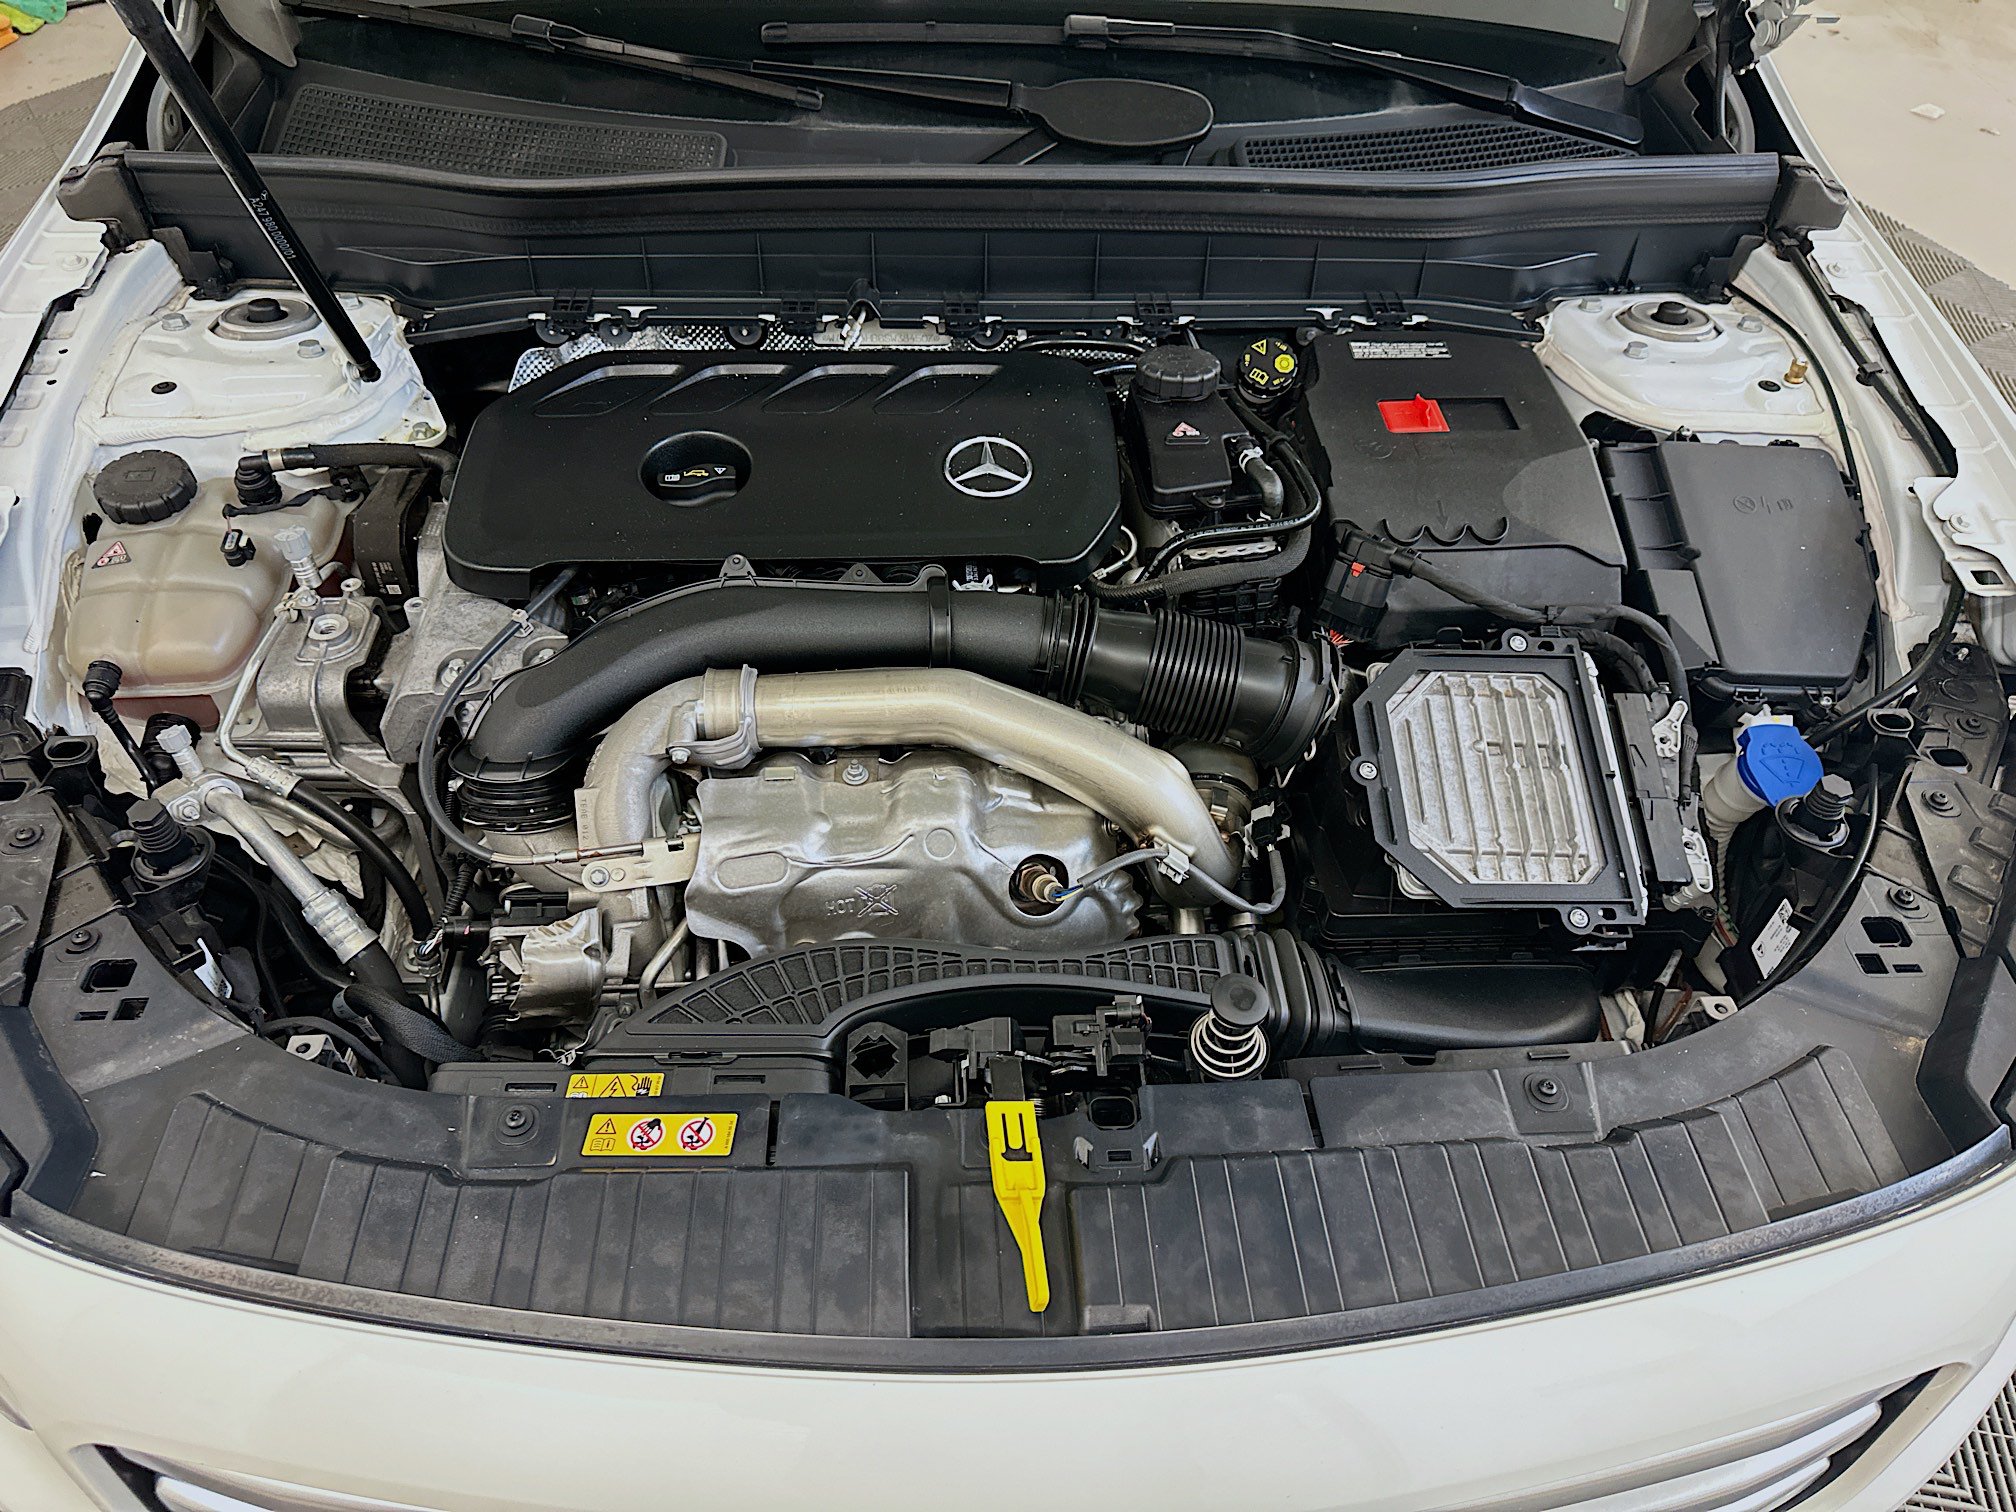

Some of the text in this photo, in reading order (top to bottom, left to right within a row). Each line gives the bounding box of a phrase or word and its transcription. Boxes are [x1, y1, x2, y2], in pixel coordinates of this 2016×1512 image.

[249, 197, 297, 259] A247 980 0000/01
[825, 898, 855, 916] HOT
